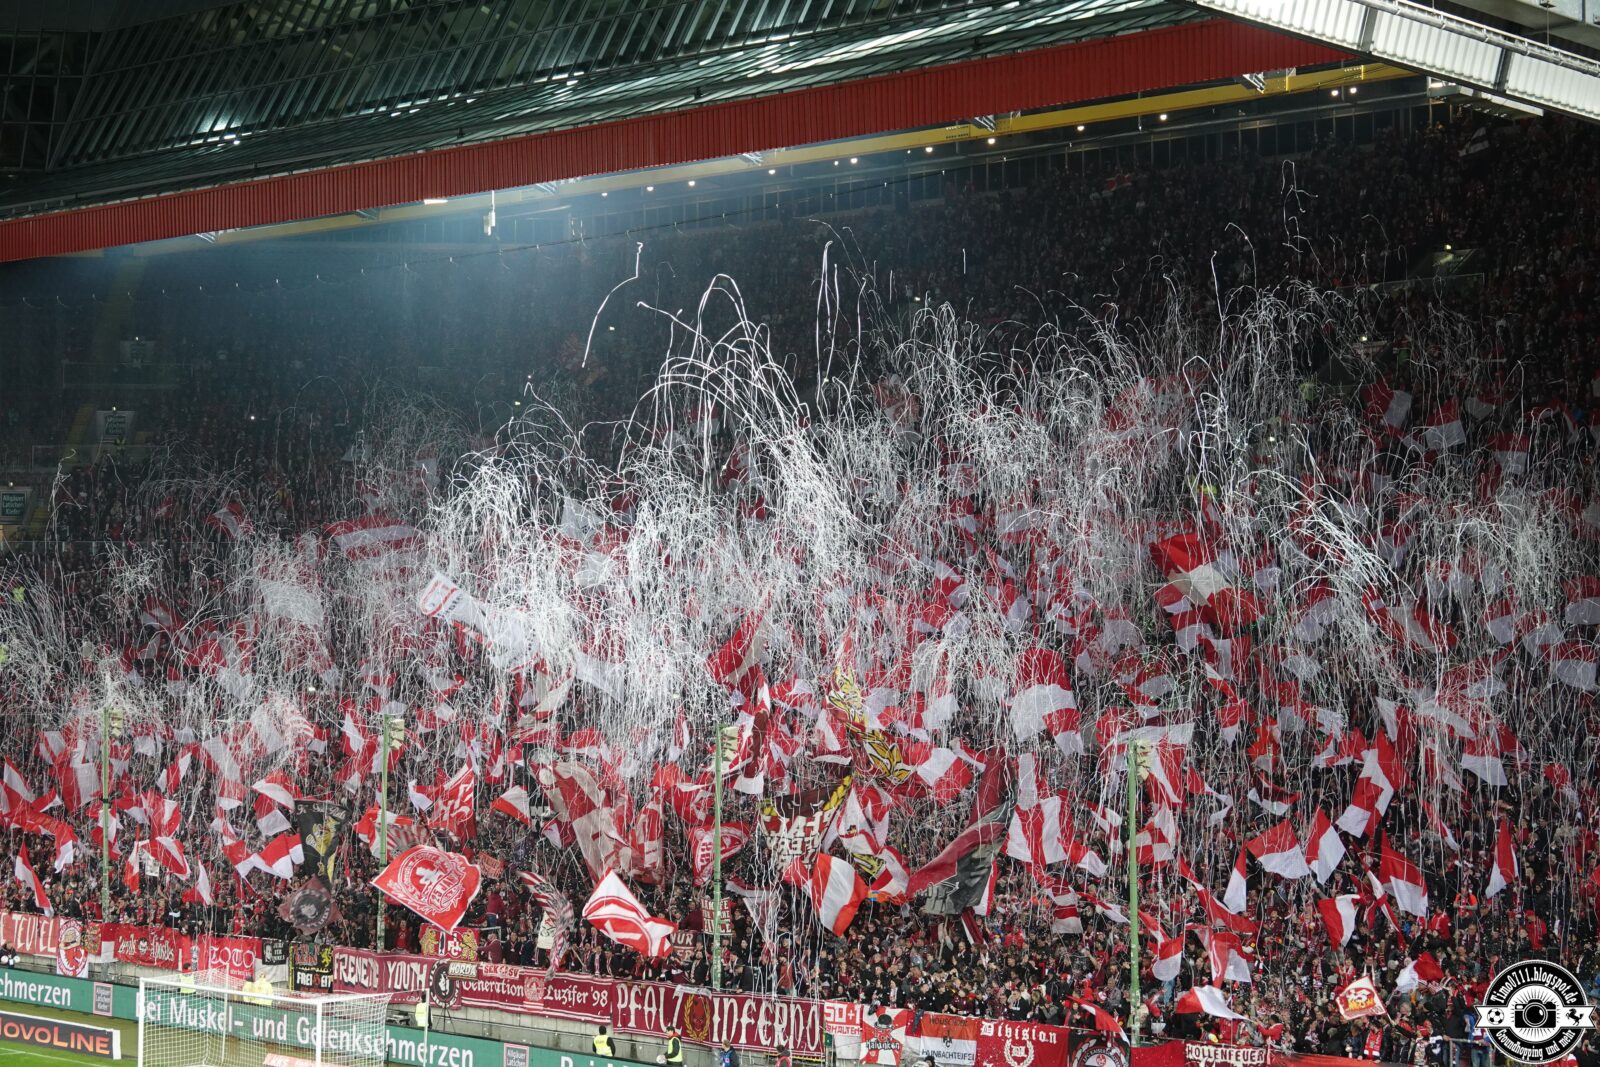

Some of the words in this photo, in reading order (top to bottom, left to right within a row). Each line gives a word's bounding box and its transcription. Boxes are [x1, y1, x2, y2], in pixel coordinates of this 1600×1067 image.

[386, 960, 427, 992] YOUTH
[462, 976, 524, 997] Generation
[544, 984, 588, 1005] Luzifer
[170, 997, 244, 1033] Muskel-
[252, 1014, 287, 1041] und
[296, 1016, 474, 1067] Gelenkschmerzen
[616, 983, 684, 1035] PFALZ
[712, 997, 820, 1051] INFERNO
[980, 1020, 1057, 1045] Division
[0, 1017, 110, 1055] OVOLINE
